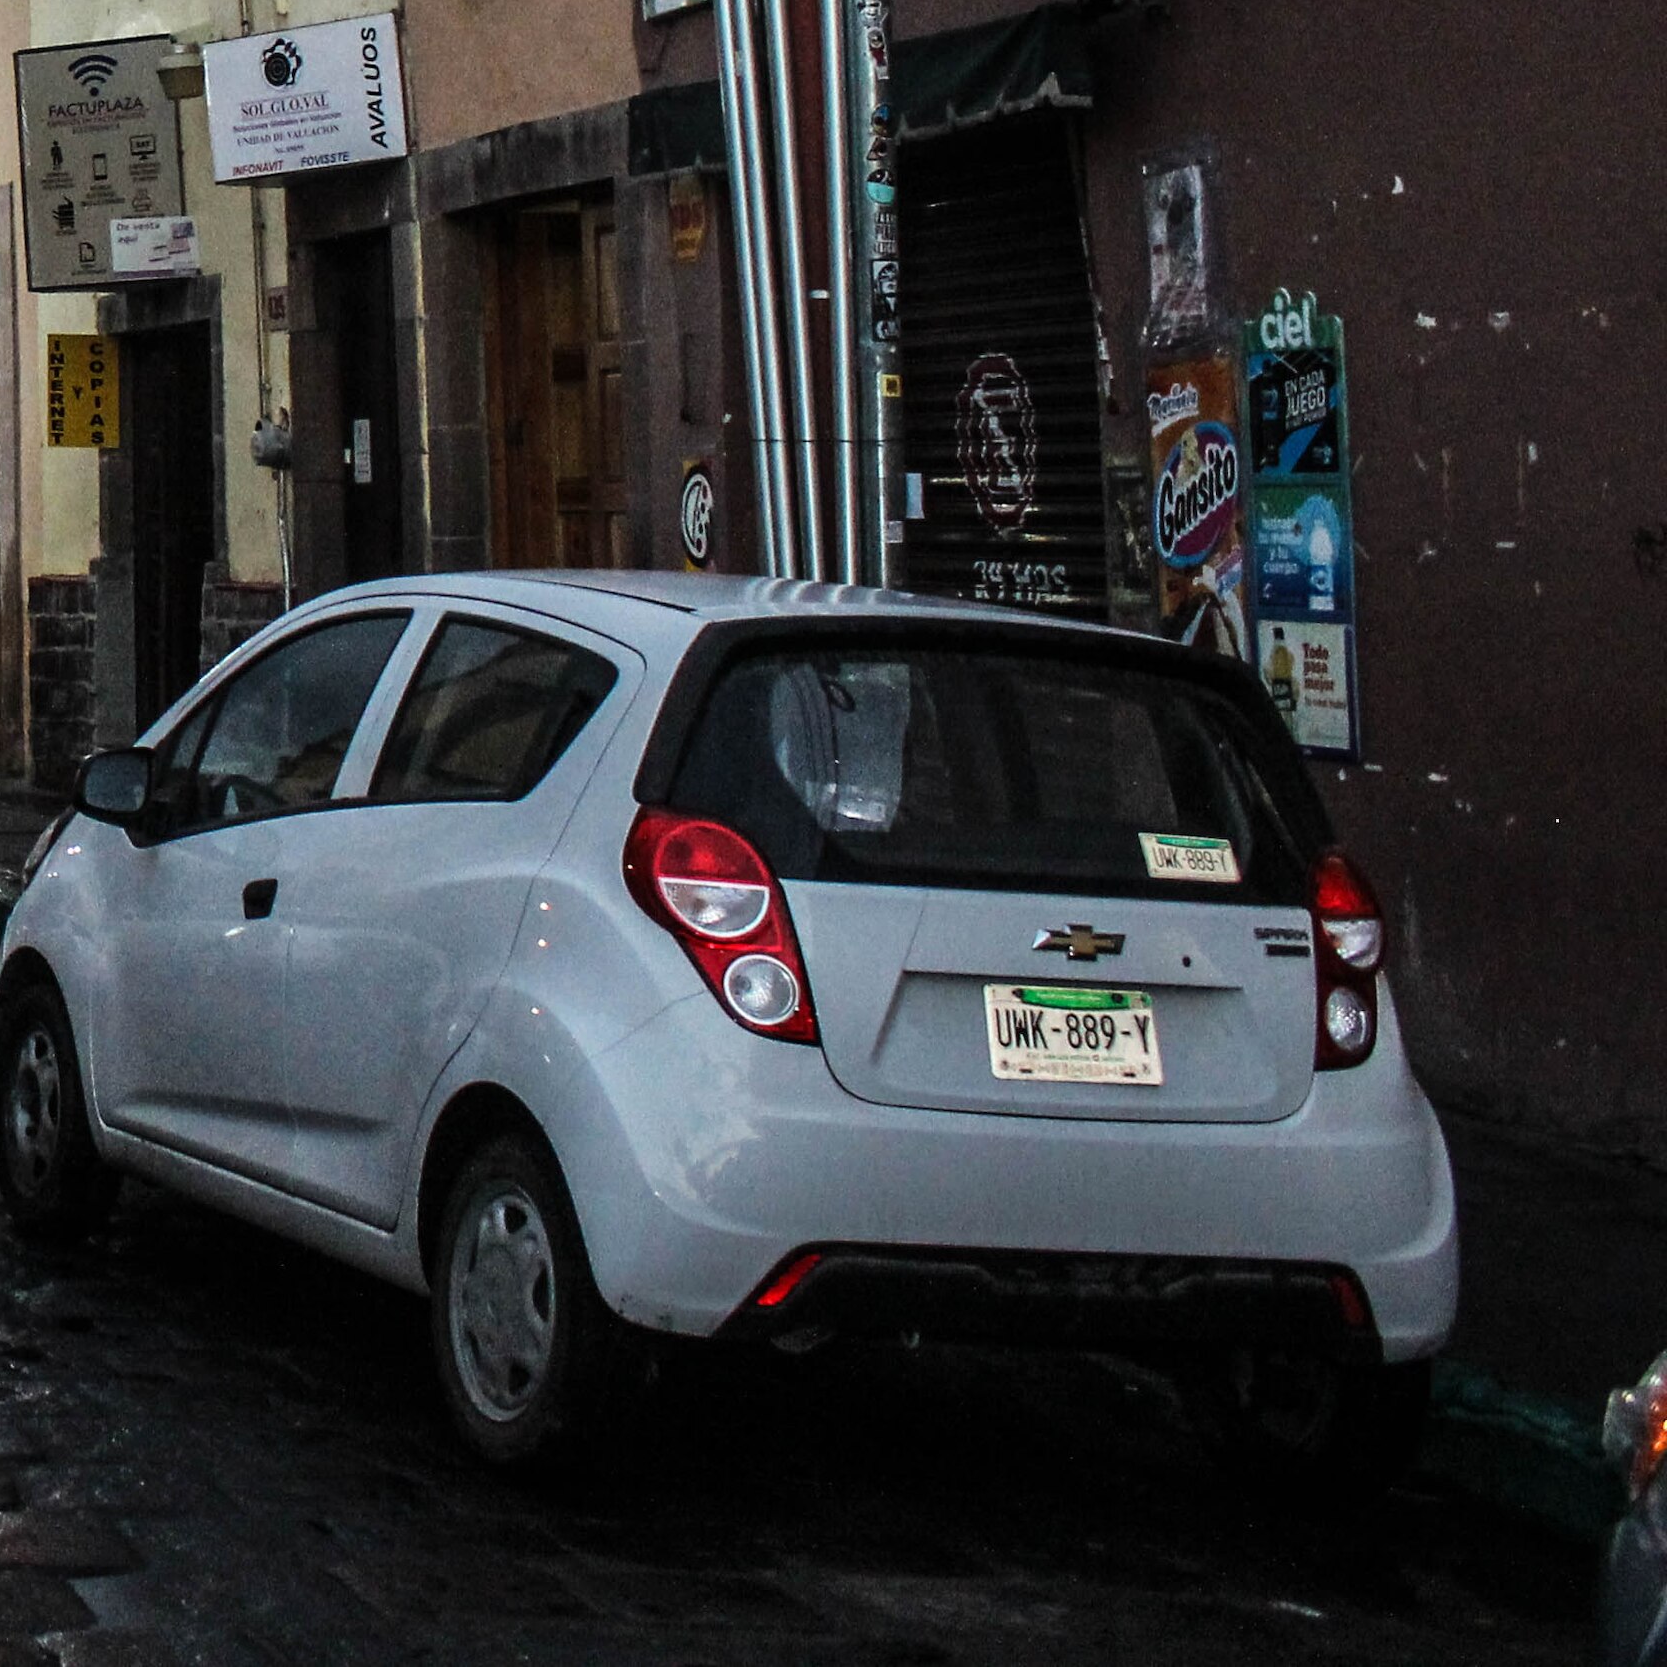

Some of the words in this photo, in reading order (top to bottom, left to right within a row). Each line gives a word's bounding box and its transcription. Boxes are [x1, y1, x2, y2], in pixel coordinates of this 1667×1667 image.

[48, 96, 144, 118] FACTUPLAZA
[360, 26, 389, 150] AVALUOS
[232, 159, 285, 177] INFONAVIT
[300, 150, 351, 168] FOVISSTE
[1260, 291, 1314, 349] ciel
[49, 339, 65, 445] INTERNET
[89, 342, 105, 444] COPIAS
[1156, 443, 1239, 558] Gansito
[1152, 846, 1228, 872] UWK-889-Y
[995, 1007, 1150, 1055] UWK-889-Y
